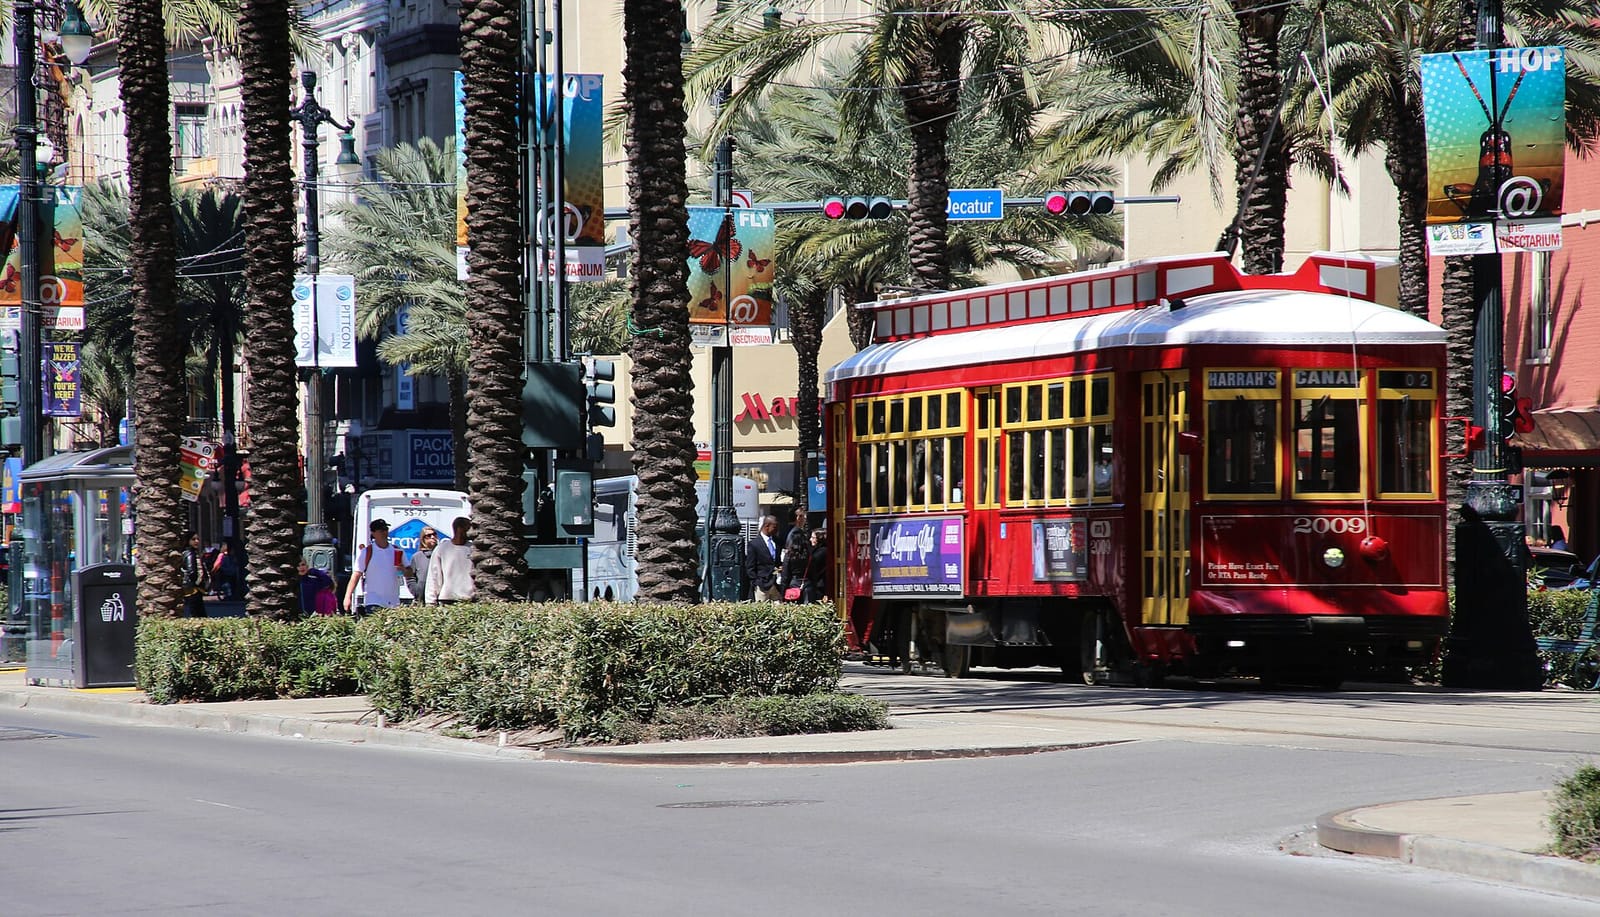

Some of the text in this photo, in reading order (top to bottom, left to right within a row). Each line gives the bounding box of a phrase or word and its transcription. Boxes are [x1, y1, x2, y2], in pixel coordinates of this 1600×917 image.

[1500, 48, 1563, 73] HOP
[42, 187, 79, 205] FLY
[739, 212, 769, 228] FLY
[1507, 221, 1526, 234] the
[1499, 233, 1560, 249] INSECTARIUM
[539, 263, 603, 276] ISTARIUM
[41, 317, 81, 327] SECTARIUM
[300, 304, 310, 349] PITTCON
[341, 304, 351, 350] PITTCON
[1208, 370, 1277, 387] HARRAH'S
[1296, 370, 1361, 385] CANAL
[734, 392, 800, 422] Mar
[413, 438, 453, 451] PACK
[1293, 517, 1367, 534] 2009
[1228, 562, 1244, 570] Have
[1233, 571, 1248, 579] Pass
